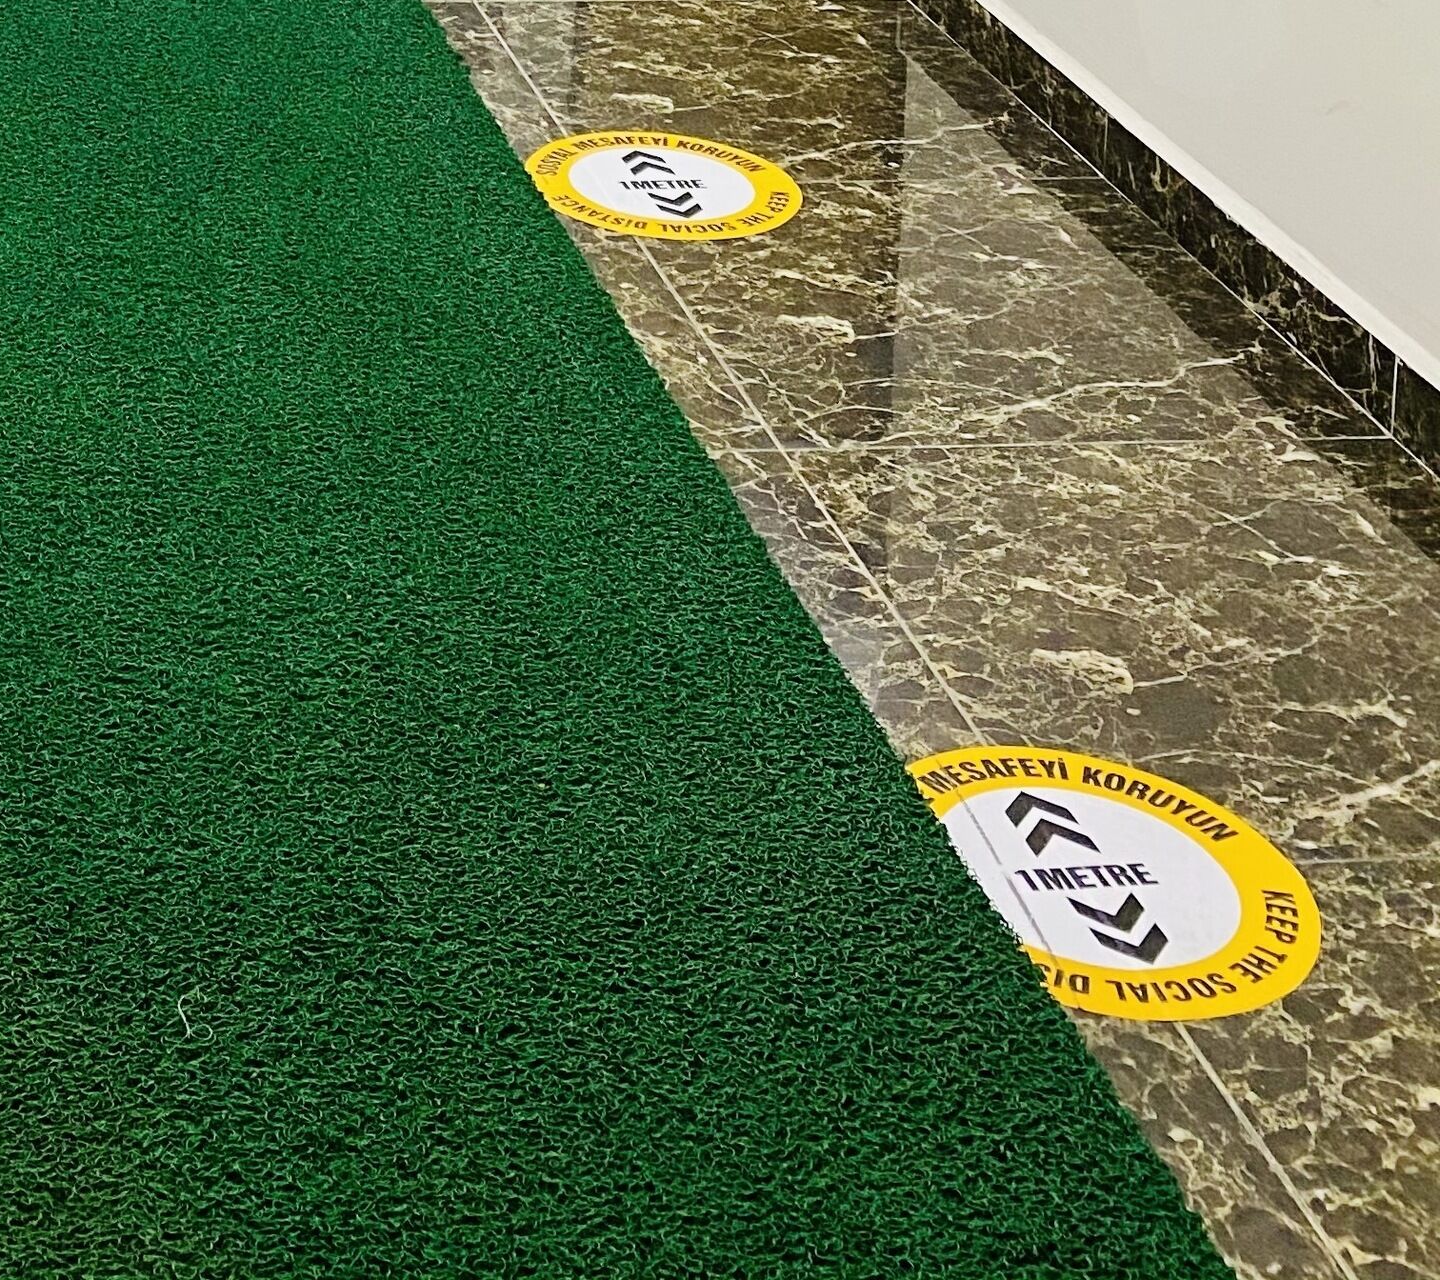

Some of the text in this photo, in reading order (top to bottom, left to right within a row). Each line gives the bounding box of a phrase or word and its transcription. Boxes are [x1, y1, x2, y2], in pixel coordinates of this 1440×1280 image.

[536, 136, 767, 176] SOSYAL MESAFEYİ KORUYUN
[619, 179, 708, 190] 1METRE
[552, 195, 648, 230] DISTANCE
[656, 222, 737, 233] SOCIAL
[735, 212, 775, 227] THE
[916, 757, 1239, 842] MESAFEYİ KORUYUN
[1015, 862, 1160, 892] 1METRE
[1261, 889, 1299, 946] KEEP
[1228, 945, 1289, 985] THE
[1105, 973, 1238, 1004] SOCIAL
